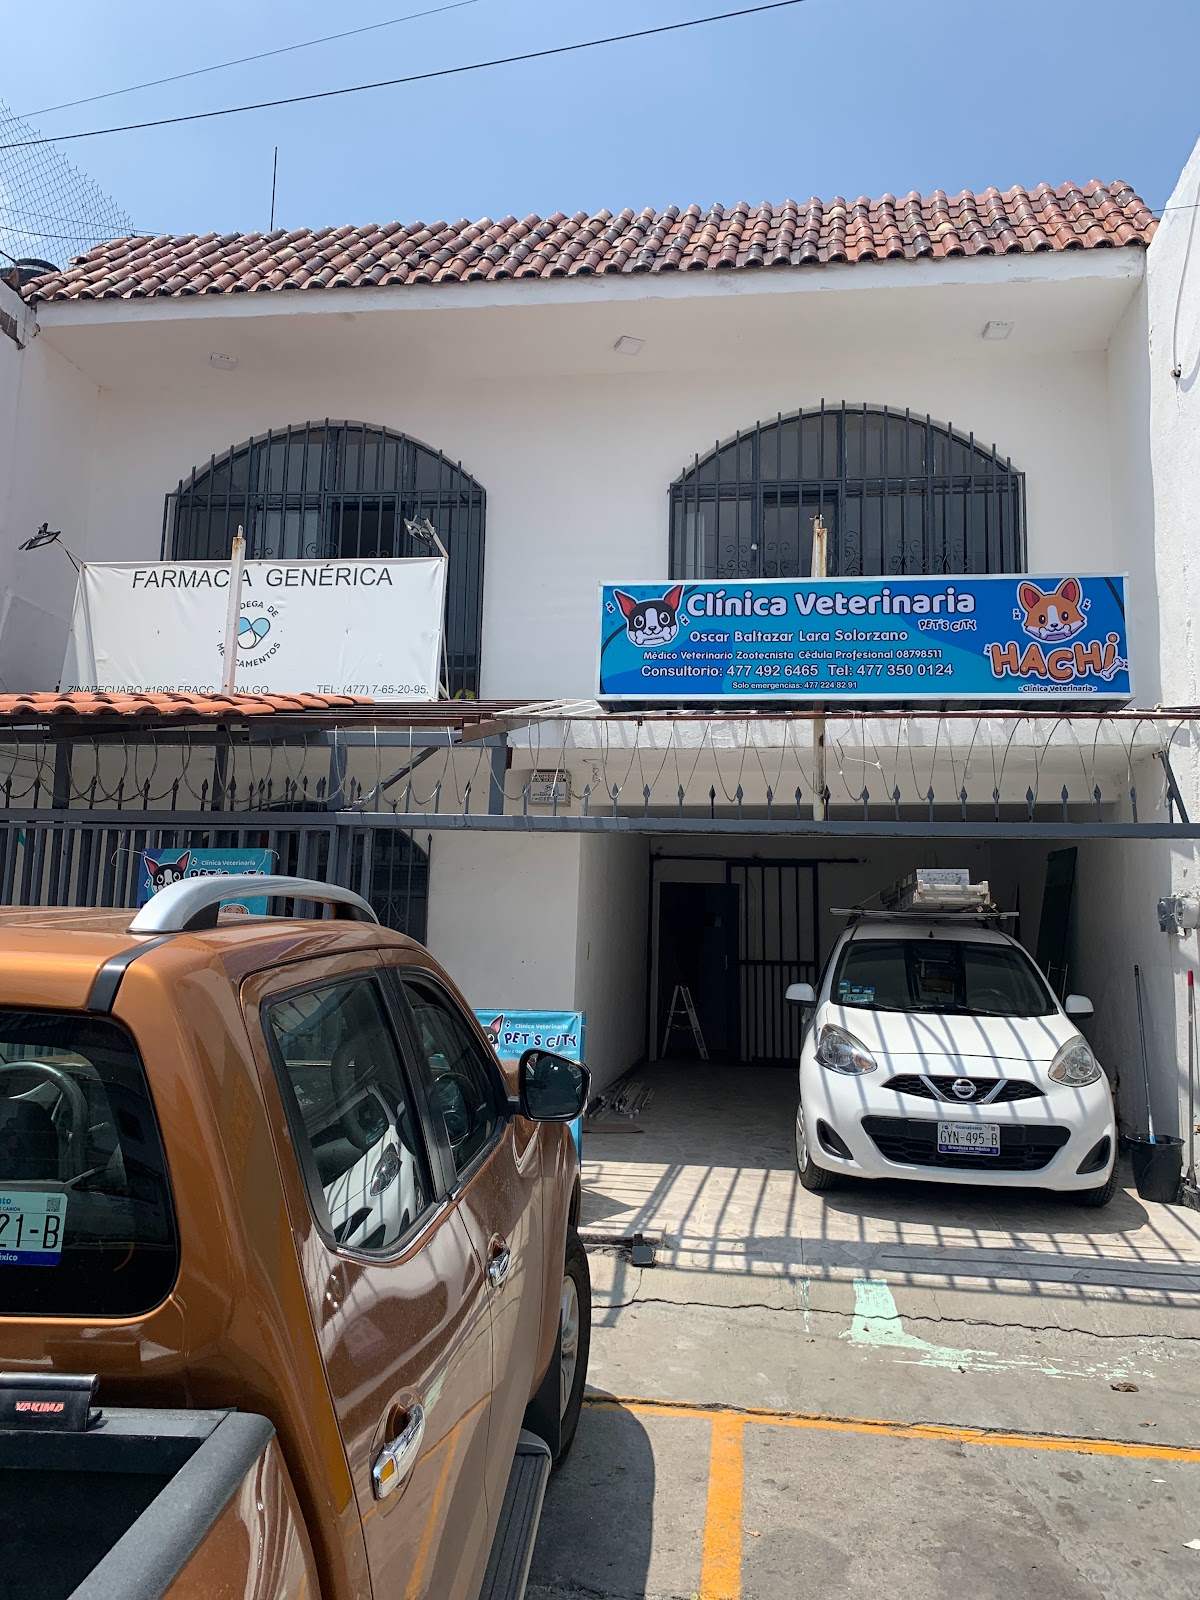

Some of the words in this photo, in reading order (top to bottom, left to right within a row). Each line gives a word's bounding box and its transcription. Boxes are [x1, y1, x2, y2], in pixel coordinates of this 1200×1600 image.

[132, 569, 253, 589] FARMACA
[265, 564, 393, 587] GENÉRICA
[686, 589, 788, 617] Clínica
[794, 587, 976, 616] Veterinaria
[267, 605, 279, 617] DE
[918, 619, 949, 631] PET'S
[950, 619, 977, 632] CITY
[689, 630, 730, 643] Oscar
[734, 630, 794, 643] Baltazar
[799, 630, 830, 642] Lara
[834, 628, 909, 642] Solorzano
[216, 642, 281, 667] MEAMENTOS
[643, 651, 678, 660] Médico
[680, 651, 734, 660] Veterinario
[736, 651, 794, 660] Zootecnista
[798, 650, 833, 660] Cédula
[834, 650, 894, 661] Profesional
[895, 649, 943, 660] 08798511
[641, 664, 723, 677] Consultorio:
[726, 664, 752, 677] 477
[754, 664, 781, 677] 492
[784, 664, 819, 677] 6465
[828, 664, 853, 677] Tel:
[856, 664, 883, 676] 477
[887, 664, 913, 676] 350
[917, 663, 953, 676] 0124
[144, 685, 175, 694] #1606
[317, 685, 340, 694] TEL:
[342, 684, 369, 695] (477)
[732, 681, 750, 690] Solo
[750, 681, 803, 691] emergencias:
[804, 681, 819, 690] 477
[820, 681, 835, 689] 224
[1049, 684, 1093, 692] Veterinaria
[504, 1032, 542, 1046] PET'S
[546, 1034, 577, 1048] CITY
[940, 1130, 998, 1146] GYN-495-B
[16, 1402, 64, 1412] YAKIMA
